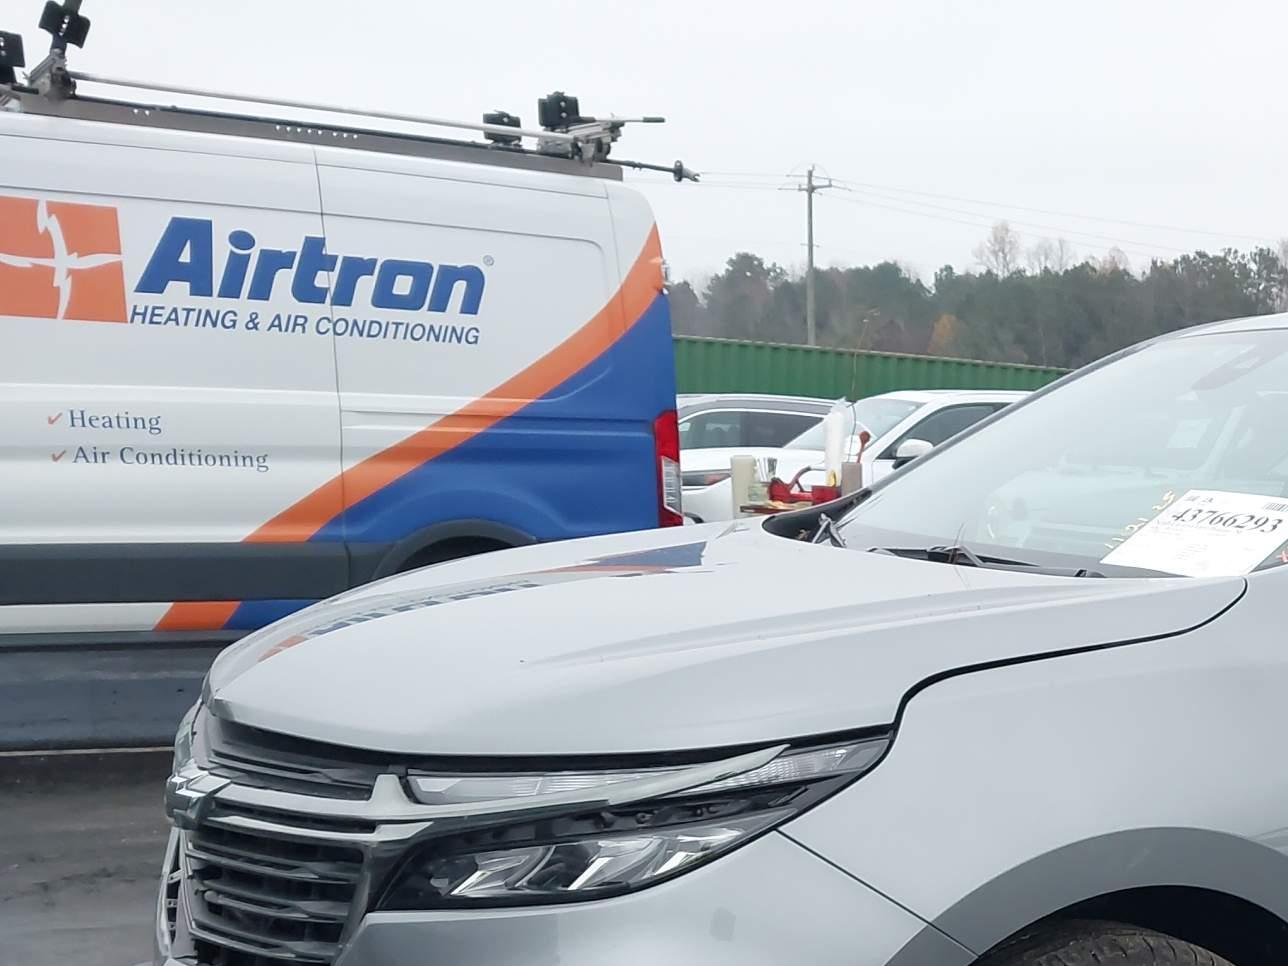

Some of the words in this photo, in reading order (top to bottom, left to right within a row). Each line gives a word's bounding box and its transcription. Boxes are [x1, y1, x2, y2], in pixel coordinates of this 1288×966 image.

[134, 217, 485, 315] Airtron
[130, 305, 238, 330] HEATING
[245, 313, 260, 331] &
[267, 315, 308, 334] AIR
[315, 317, 480, 345] CONDITIONING
[69, 409, 162, 435] Heating
[72, 446, 110, 464] Air
[119, 447, 269, 473] Conditioning
[1171, 508, 1283, 533] 43766293
